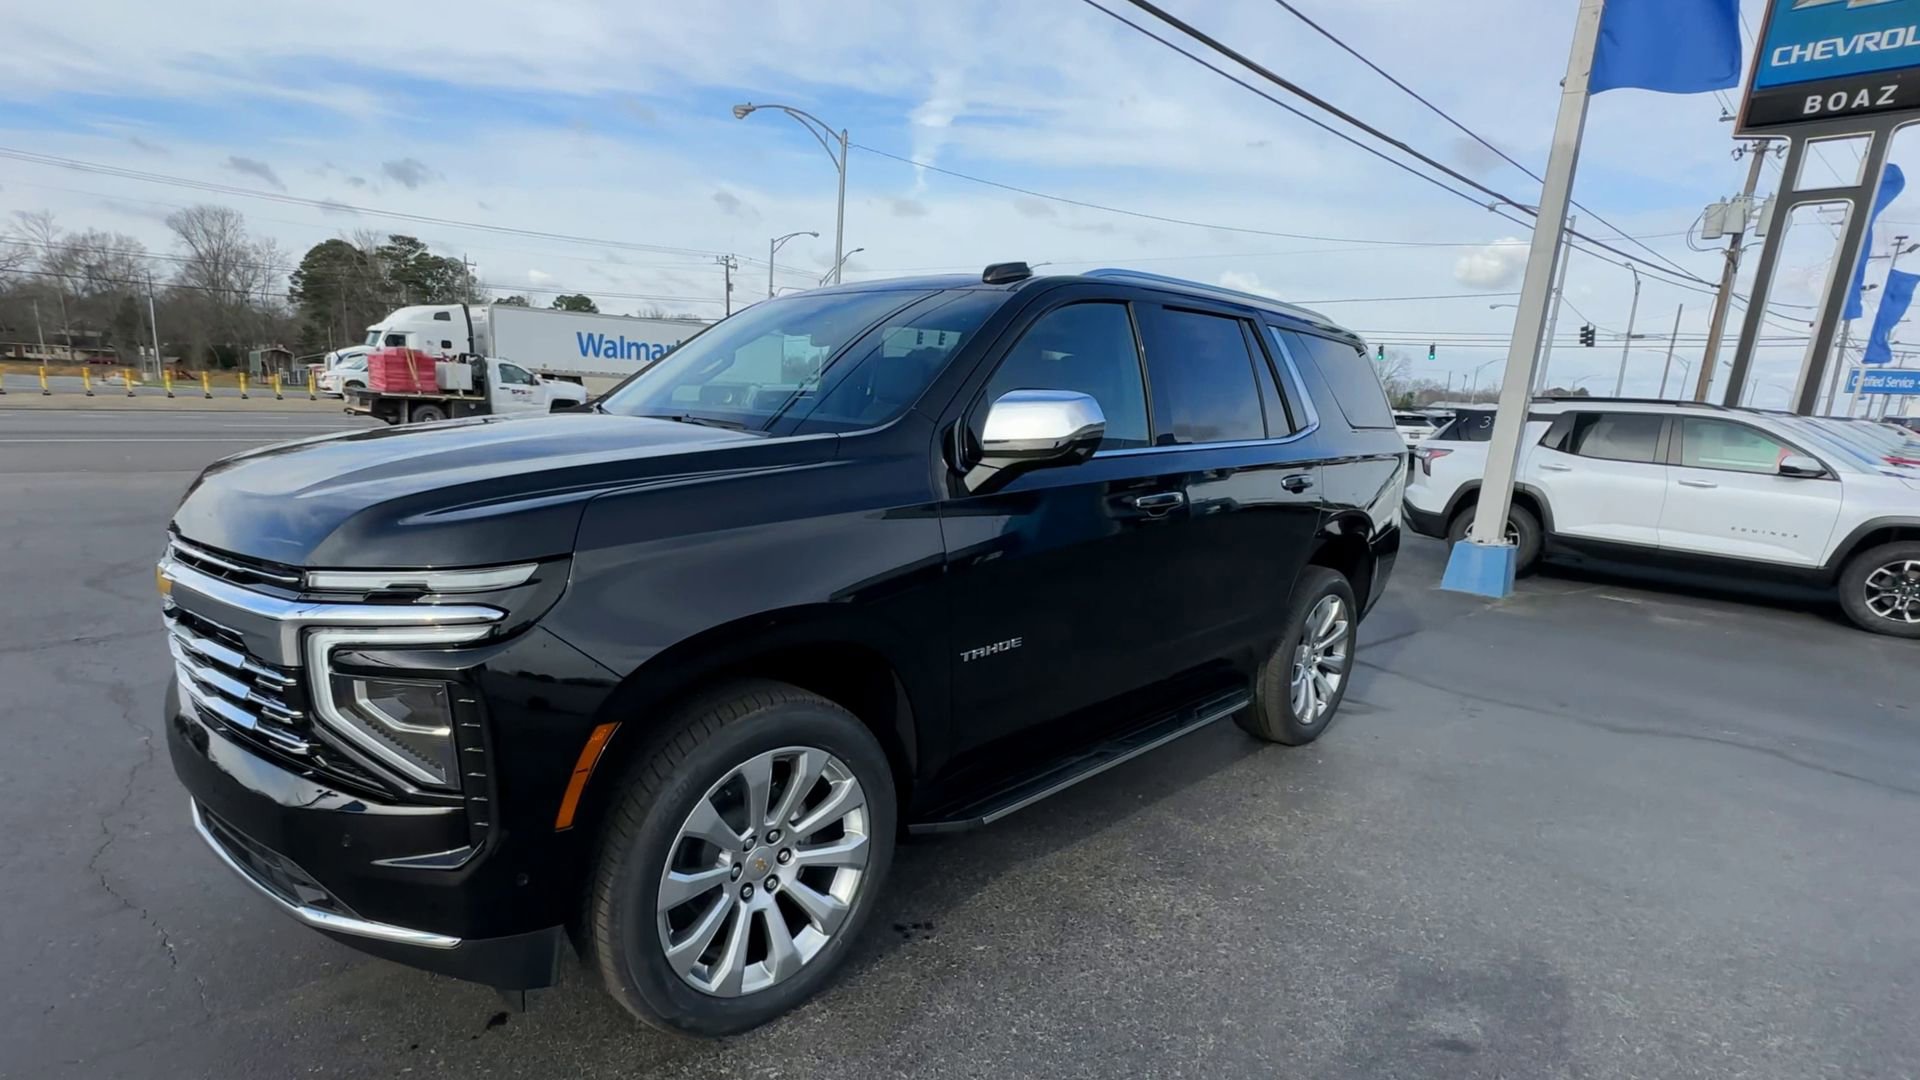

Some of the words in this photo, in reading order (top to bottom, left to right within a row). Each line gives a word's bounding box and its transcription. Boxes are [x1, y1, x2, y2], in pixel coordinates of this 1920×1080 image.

[1803, 84, 1899, 114] BOAZ
[1885, 376, 1915, 388] Service
[960, 636, 1023, 662] TAHOE
